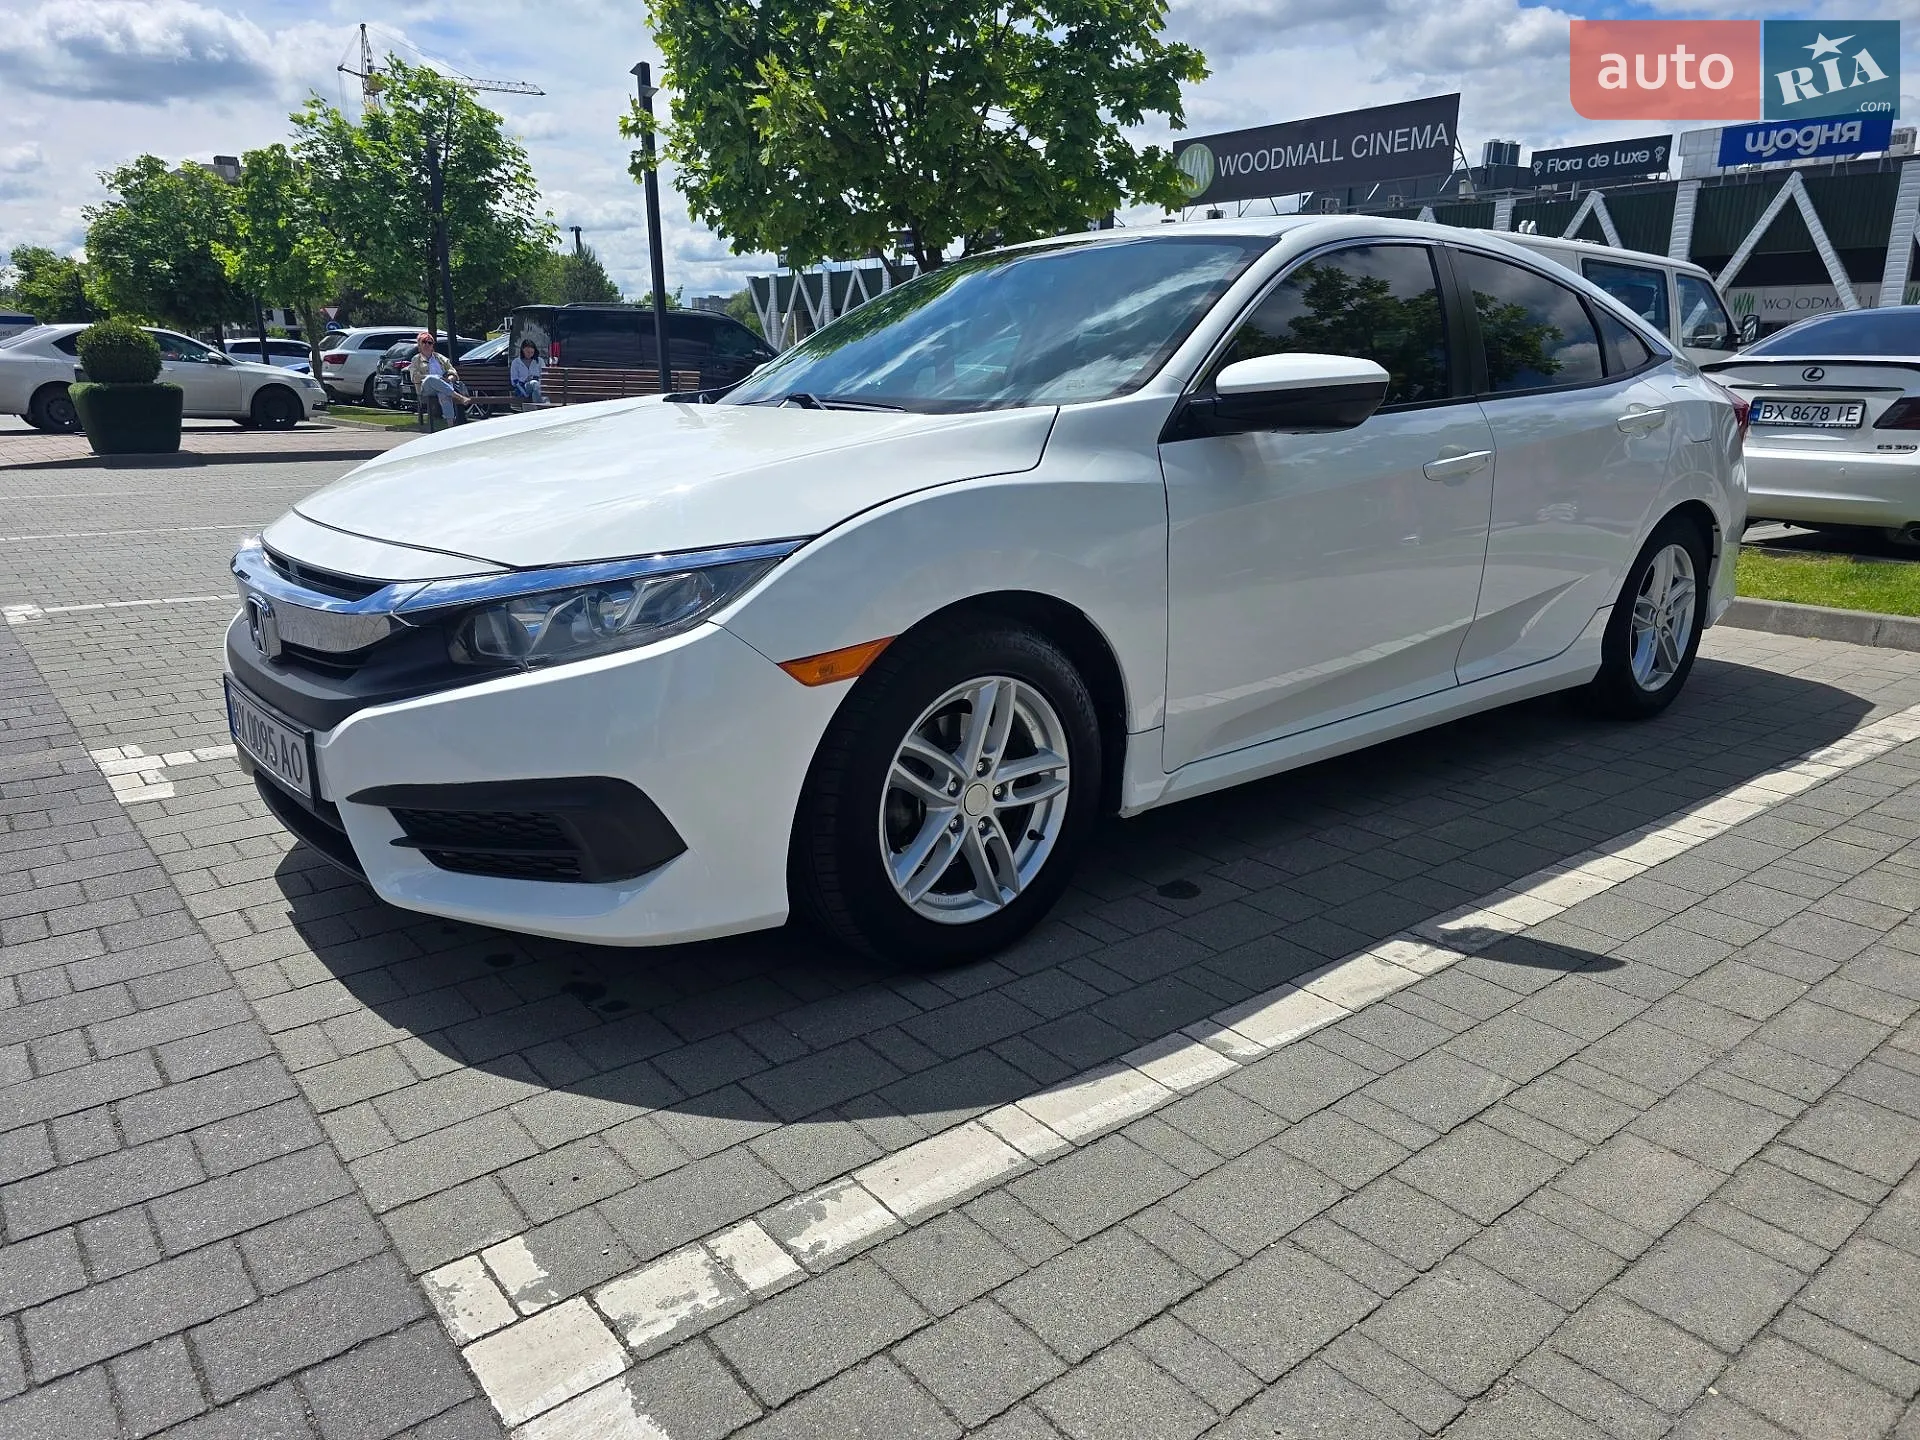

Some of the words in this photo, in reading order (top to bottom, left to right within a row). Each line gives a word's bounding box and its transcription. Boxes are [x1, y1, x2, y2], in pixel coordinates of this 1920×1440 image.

[1219, 138, 1344, 177] WOODMALL
[1351, 122, 1449, 158] CINEMA
[1745, 121, 1862, 157] щодня
[1547, 158, 1582, 173] Flora
[1588, 156, 1609, 168] de
[1614, 150, 1650, 165] Luxe
[1762, 404, 1788, 420] BX
[1790, 405, 1830, 421] 8678
[1837, 406, 1859, 422] IE
[280, 734, 303, 784] AO
